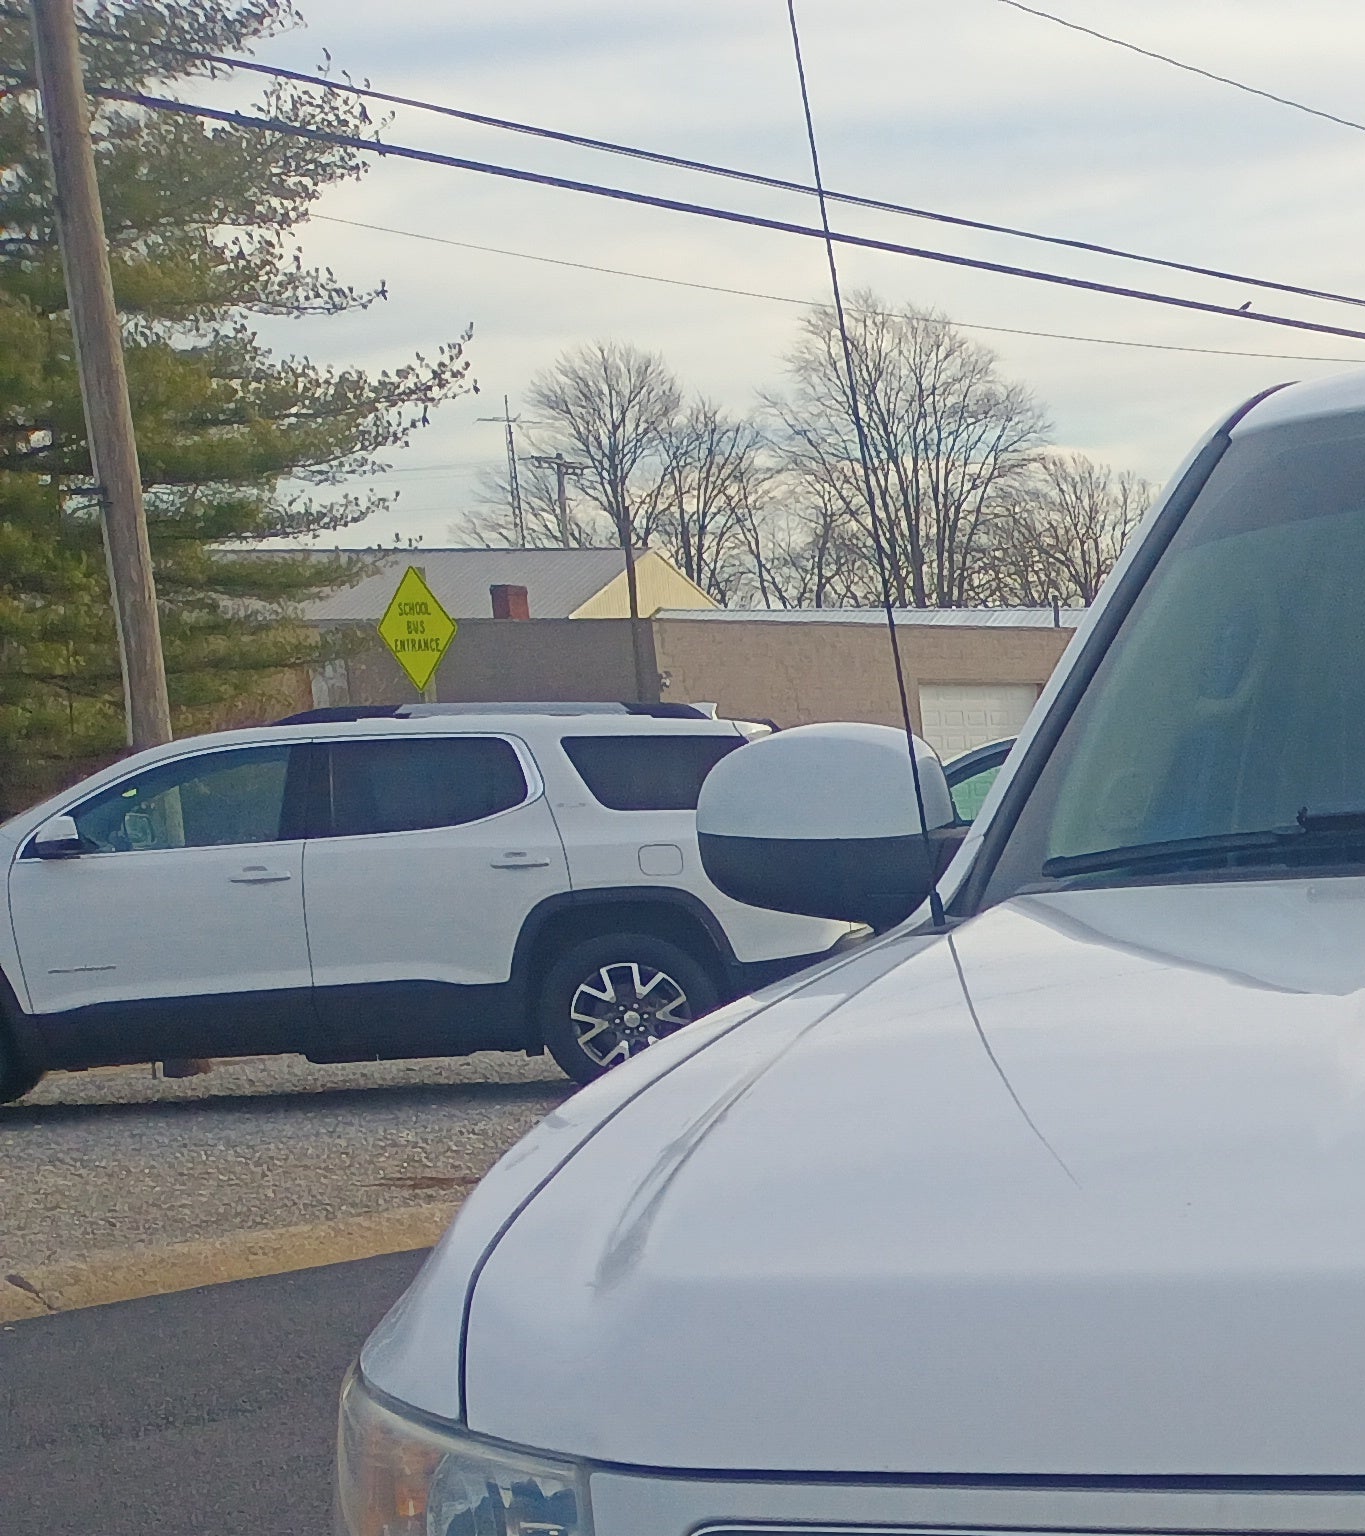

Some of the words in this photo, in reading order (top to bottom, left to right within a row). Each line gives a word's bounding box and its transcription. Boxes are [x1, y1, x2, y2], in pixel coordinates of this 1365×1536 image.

[397, 602, 431, 617] SCHOOL
[406, 620, 426, 634] BUS
[394, 638, 442, 652] ENTRANCE
